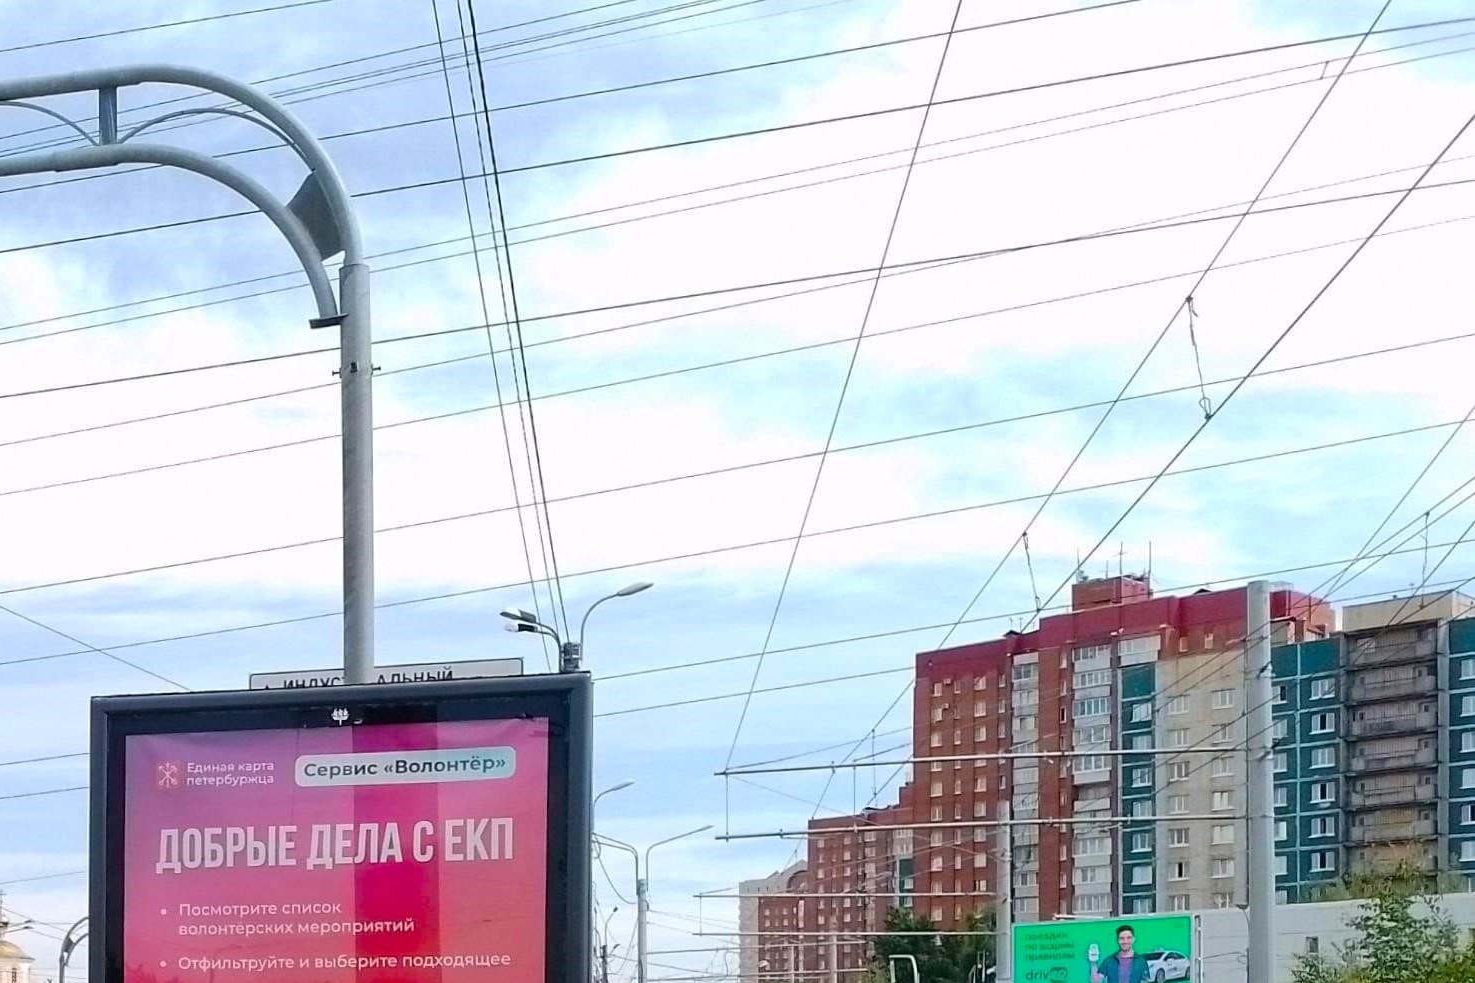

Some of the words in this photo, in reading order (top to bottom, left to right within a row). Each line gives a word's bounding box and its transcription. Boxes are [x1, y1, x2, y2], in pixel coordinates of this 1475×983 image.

[186, 762, 235, 773] Единая
[238, 762, 275, 773] карта
[304, 761, 378, 781] Сервис
[383, 754, 506, 777] «Волонтёр»
[186, 773, 275, 787] петербуржца
[155, 825, 297, 874] ДОБРЫЕ
[306, 822, 403, 871] ДЕЛА
[413, 820, 434, 862] С
[444, 818, 514, 861] ЕКП
[179, 903, 278, 919] Посмотрите
[282, 903, 341, 915] список
[298, 918, 415, 936] мероприятий
[178, 954, 295, 972] Отфильтруйте
[299, 958, 310, 968] и
[314, 954, 398, 969] выберите
[403, 953, 511, 968] подходящее
